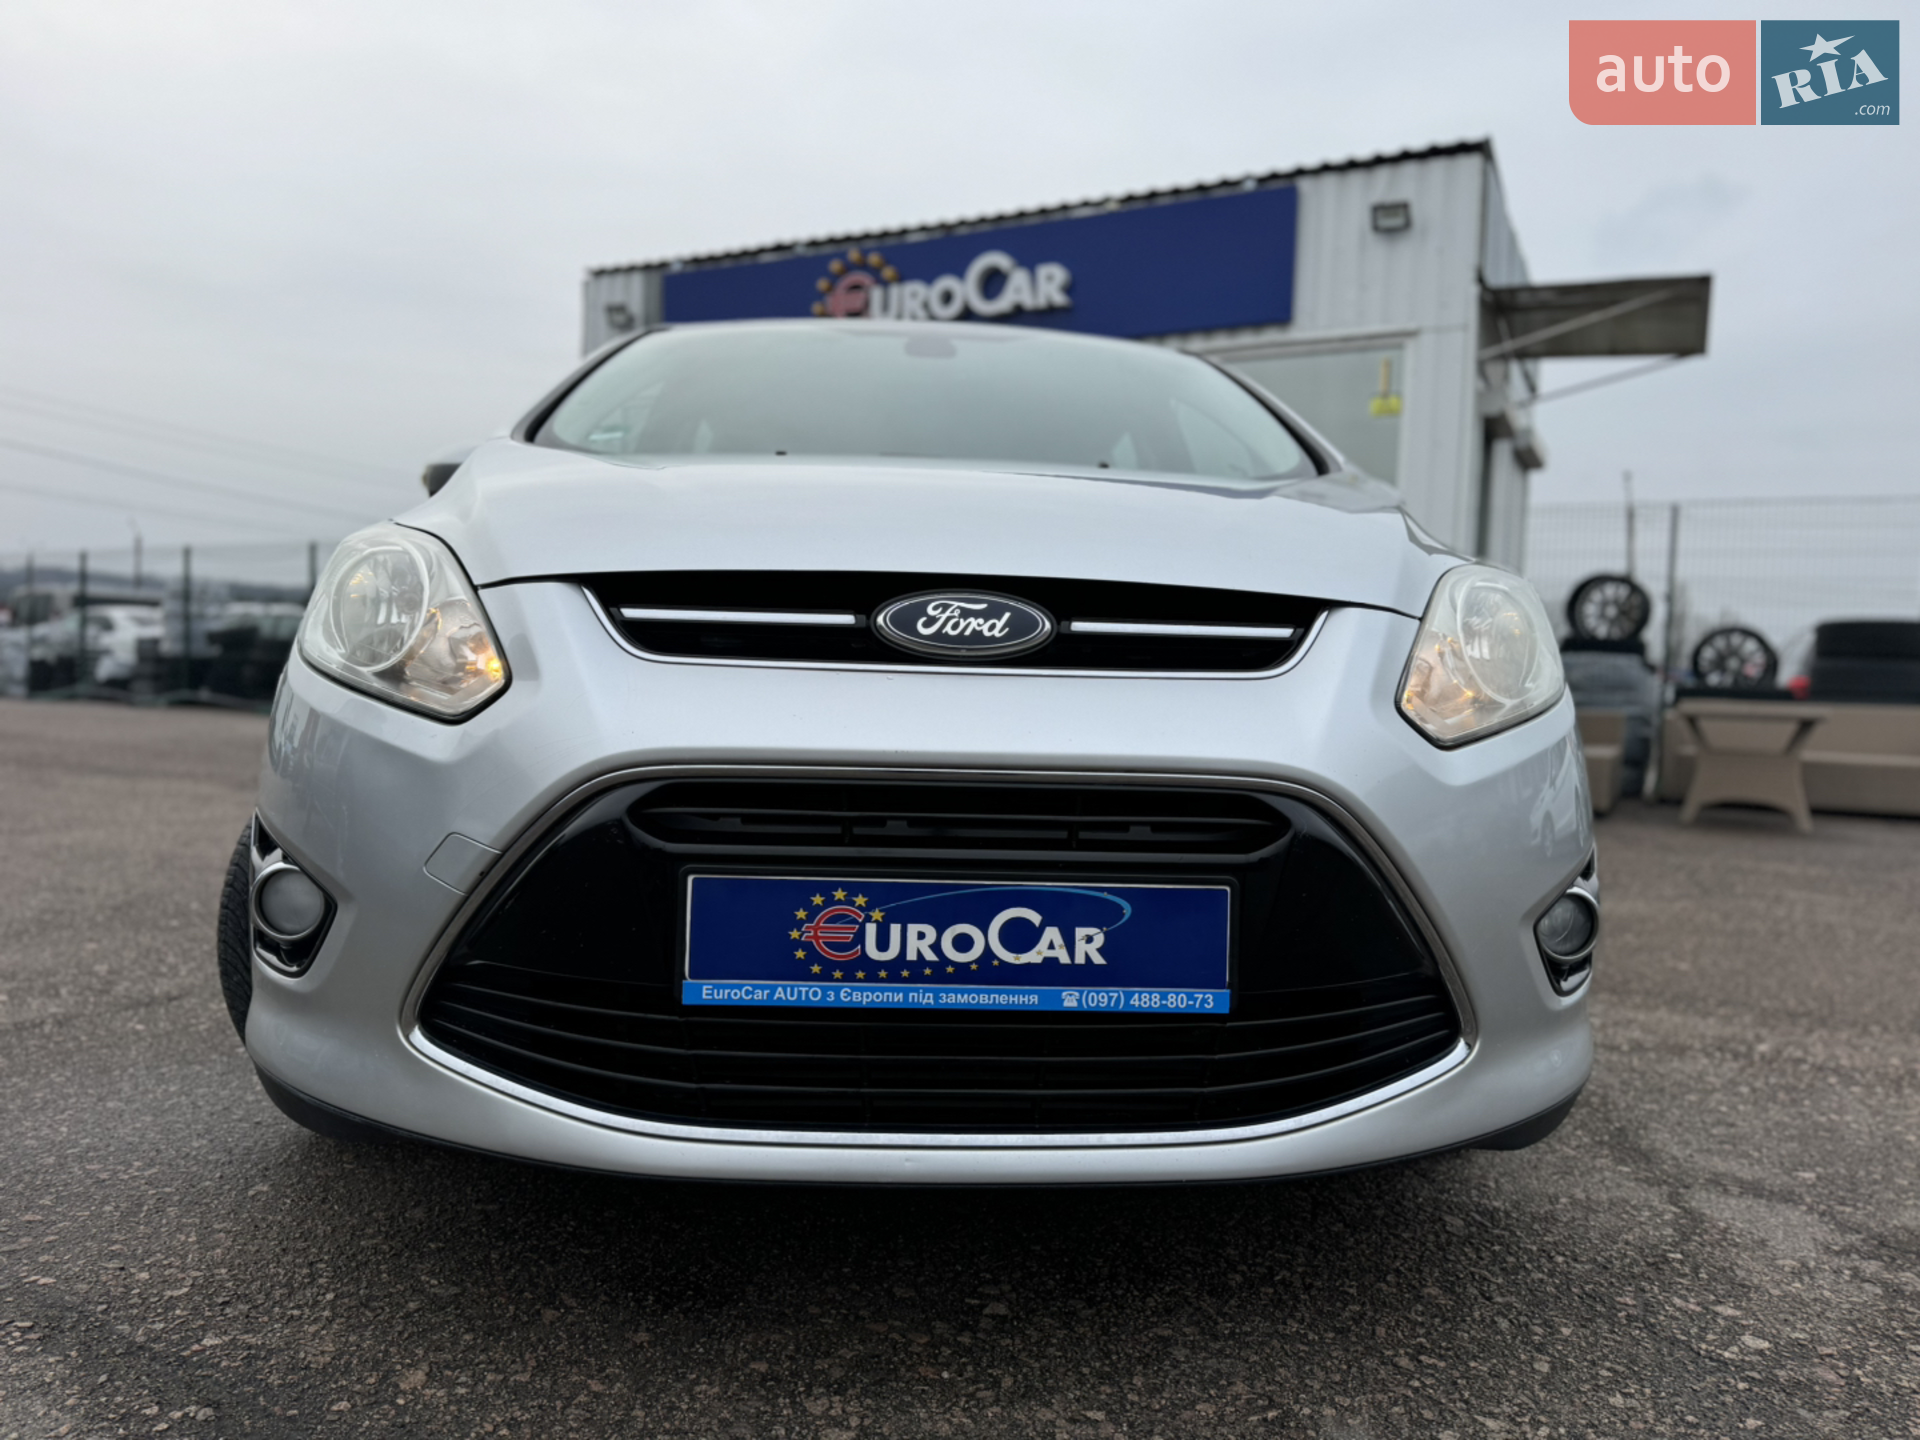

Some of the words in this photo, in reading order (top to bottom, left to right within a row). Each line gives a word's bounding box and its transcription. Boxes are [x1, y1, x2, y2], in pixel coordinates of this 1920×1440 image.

[916, 599, 1012, 638] Ford
[702, 985, 770, 1001] EuroCar
[773, 986, 822, 1002] AUTO
[839, 987, 904, 1006] Європи
[908, 989, 934, 1006] під
[938, 991, 1039, 1006] замовлення
[1081, 990, 1126, 1010] (097)
[1129, 992, 1215, 1010] 488-80-73
